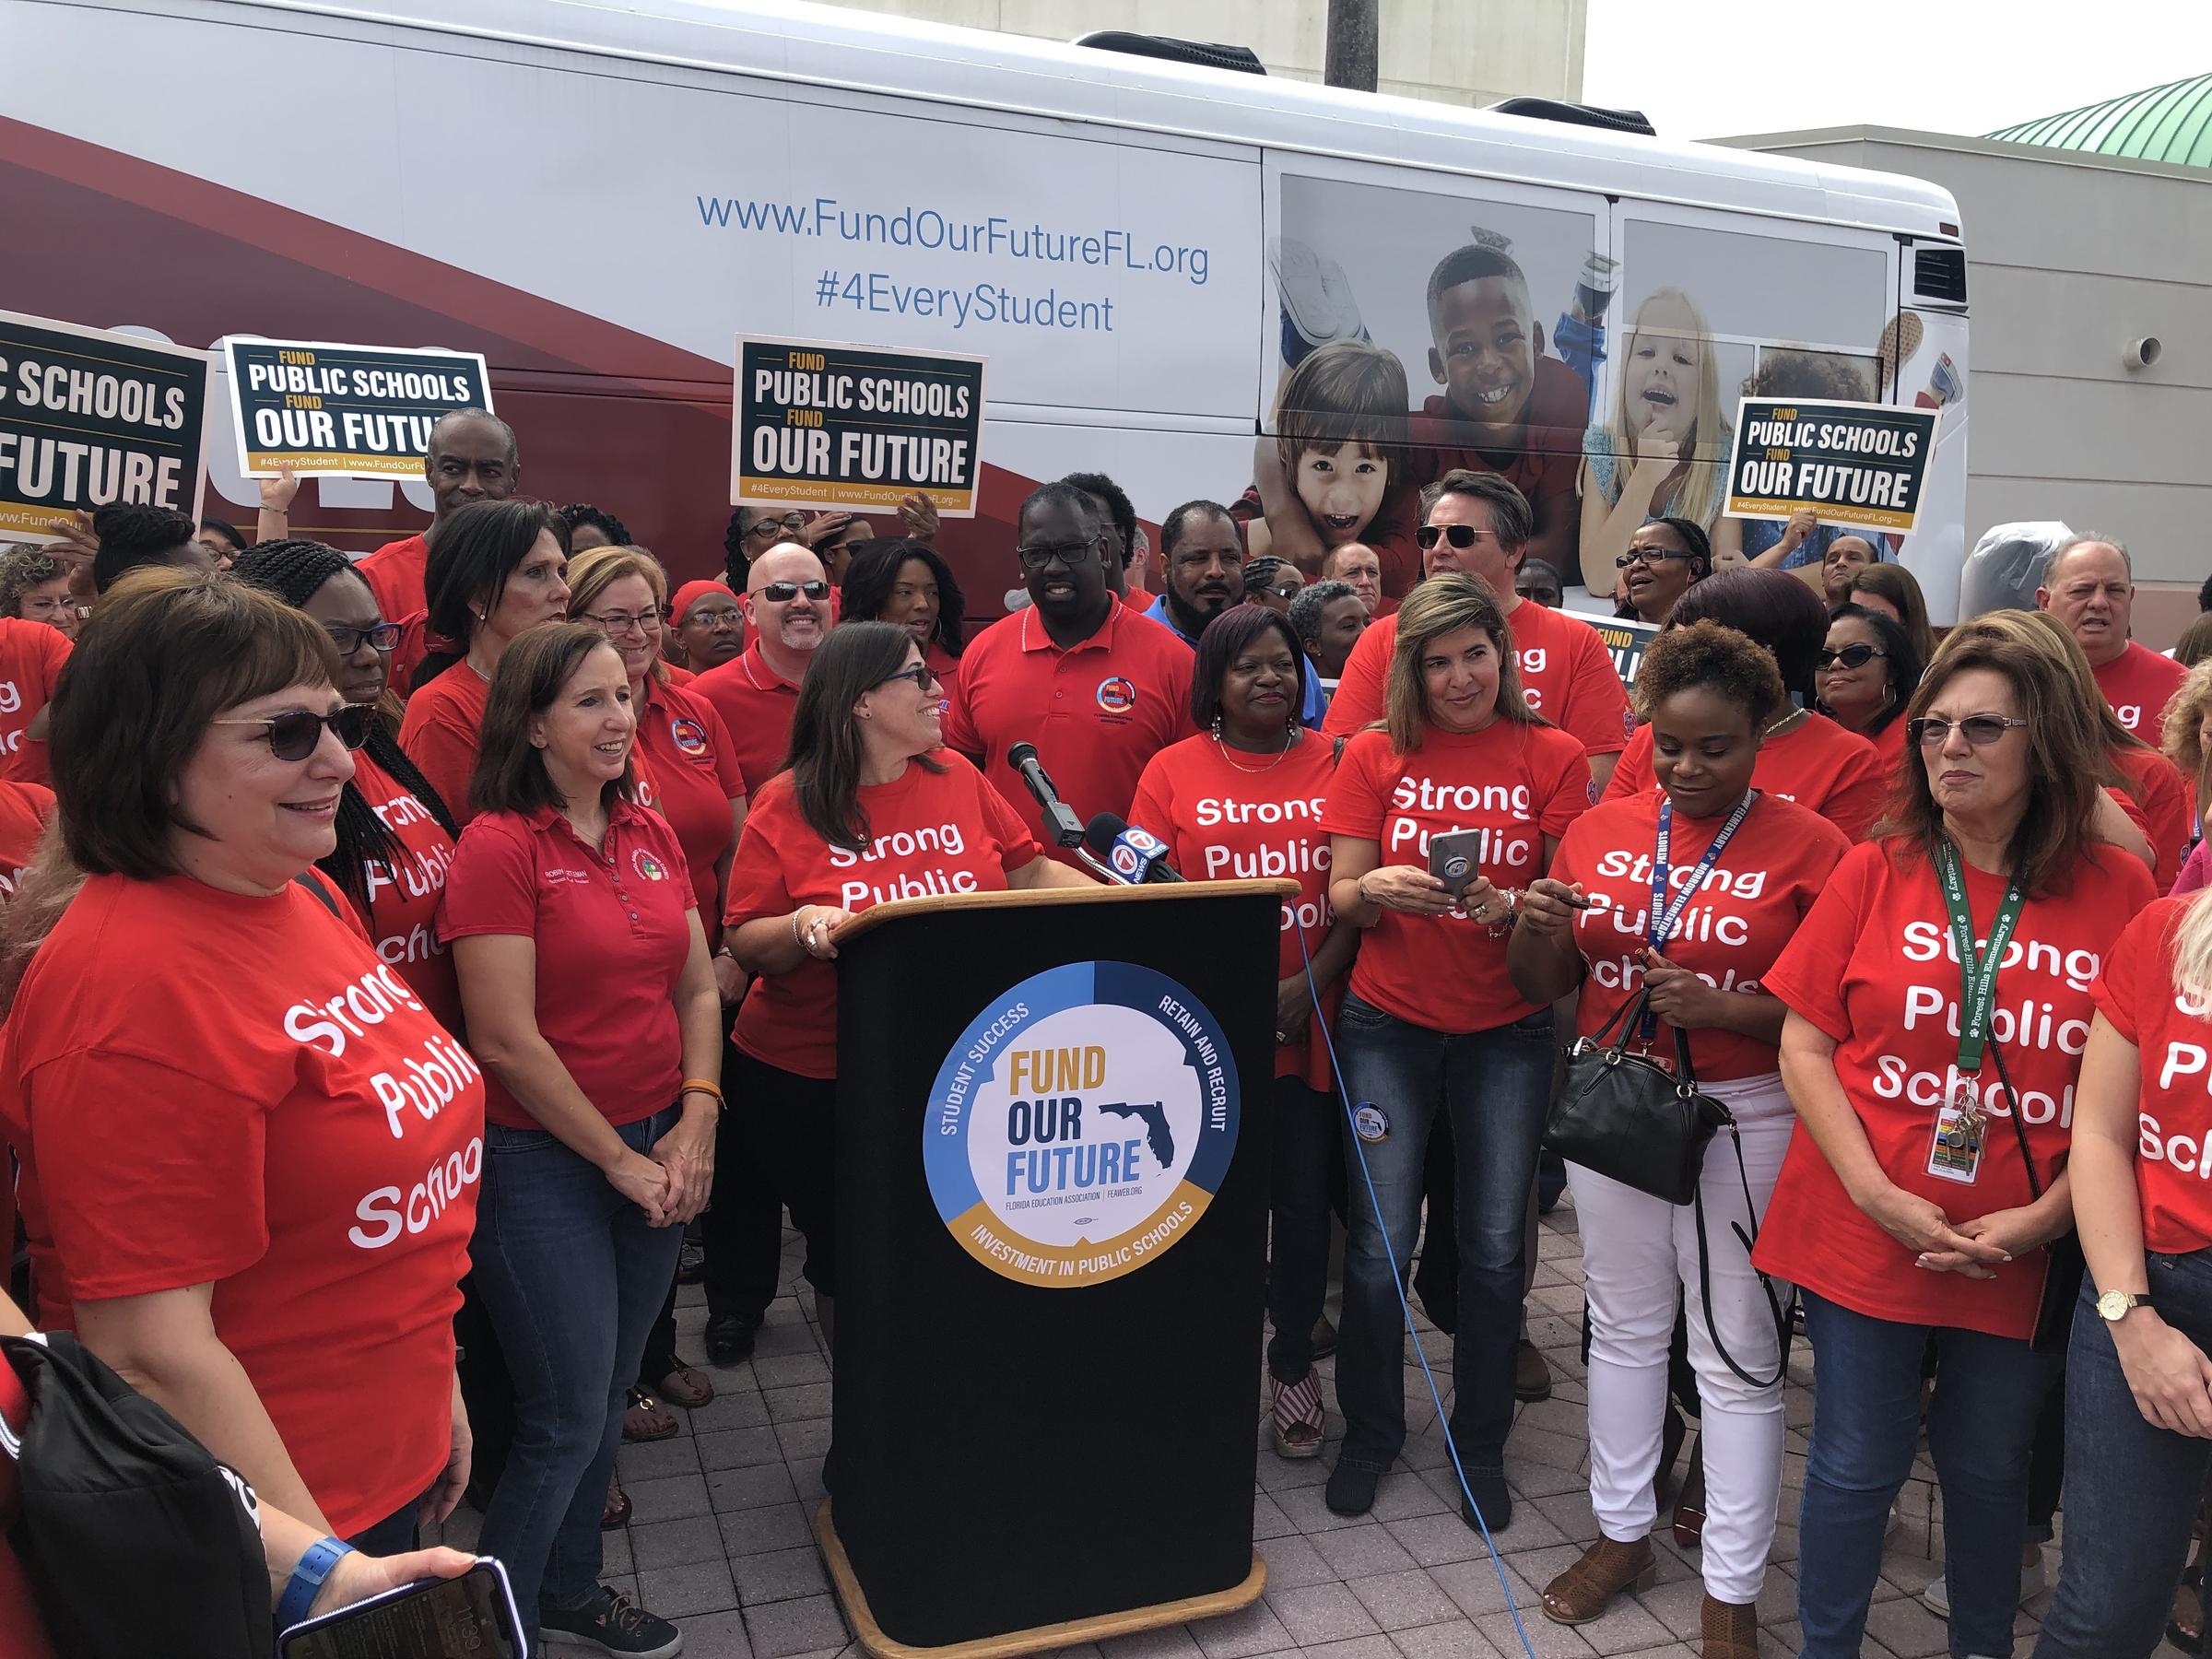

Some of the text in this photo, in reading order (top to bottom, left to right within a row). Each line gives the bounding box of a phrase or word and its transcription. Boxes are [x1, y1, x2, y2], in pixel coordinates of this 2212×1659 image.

[697, 195, 1209, 284] www.FundOurFutureFL.org
[816, 269, 1113, 331] #4EveryStudent
[278, 350, 315, 366] FUND
[788, 351, 826, 371] FUND
[16, 360, 184, 430] SCHOOLS
[248, 364, 471, 402] PUBLIC SCHOOLS
[285, 395, 322, 410] FUND
[755, 369, 970, 419] PUBLIC SCHOOLS
[254, 407, 436, 453] OUR FUTU
[786, 408, 824, 428] FUND
[1771, 407, 1797, 421] FUND
[753, 425, 968, 485] OUR FUTURE
[1747, 421, 1918, 458] PUBLIC SCHOOLS
[1765, 448, 1791, 462] FUND
[348, 459, 425, 471] www.FundOurFu
[1740, 460, 1912, 508] OUR FUTURE
[750, 483, 827, 497] #4EveryStudent
[1736, 501, 1787, 512] #4EveryStudent
[1393, 776, 1531, 820] Strong
[1145, 843, 1167, 857] NEWS
[1391, 818, 1530, 866] Plic
[1656, 830, 1669, 865] PATRIOTS
[1712, 807, 1747, 851] ELEMENTARY
[1133, 857, 1147, 884] NEWS
[1204, 838, 1332, 879] Public
[841, 868, 978, 912] Public
[1680, 862, 1710, 898] MORROW
[1901, 921, 2100, 993] Stong
[1958, 924, 1971, 952] Forest
[1983, 923, 2009, 973] Elementary
[1964, 953, 1974, 974] Hills
[1978, 973, 1990, 996] Hills
[1971, 997, 1986, 1028] Forest
[940, 1001, 1030, 1136] STUDENT SUCCESS
[1009, 1045, 1107, 1096] FUND
[1158, 994, 1227, 1133] RETAIN AND RECRUIT
[1872, 1054, 2074, 1129] School
[1007, 1097, 1083, 1146] OUR
[1006, 1138, 1142, 1196] FUTURE
[347, 1136, 484, 1249] Schoo
[1006, 1186, 1143, 1211] FLORIDA EDUCATION ASSOCIATION FEAWEB.ORG
[971, 1201, 1193, 1277] INVESTMENT IN PUBLIC SCHOOLS
